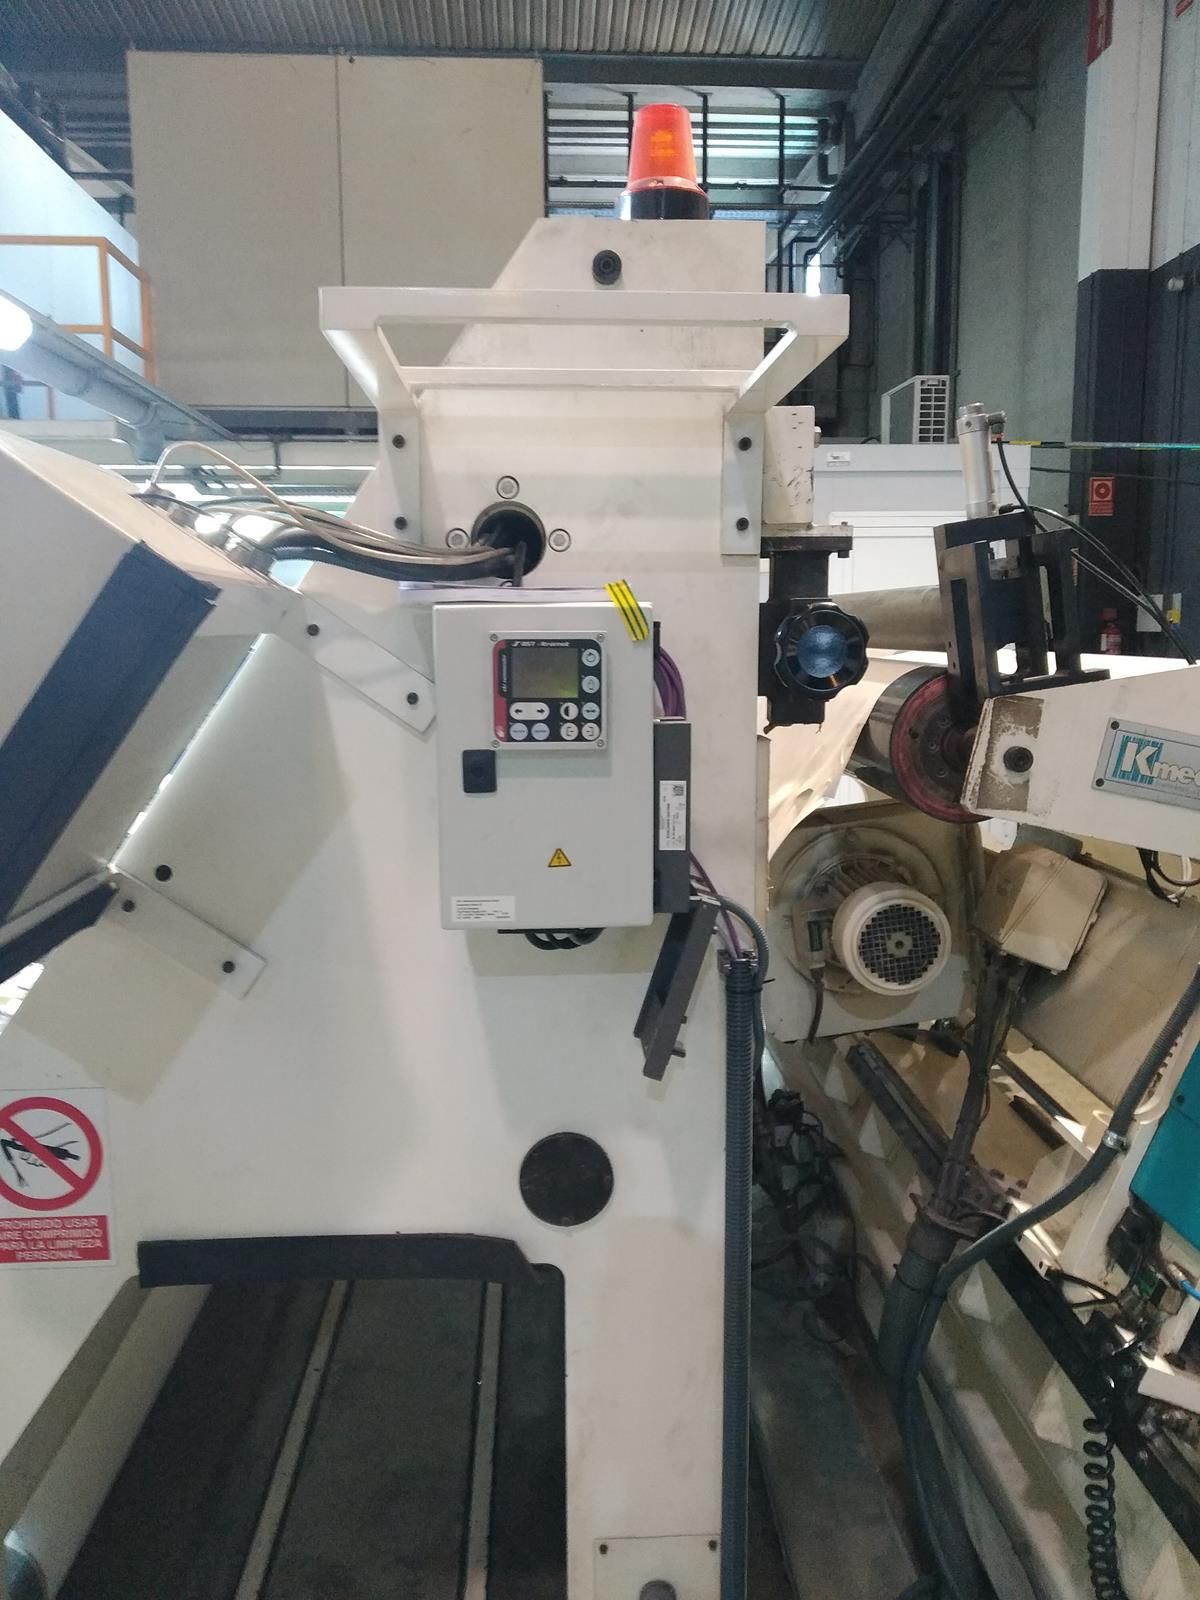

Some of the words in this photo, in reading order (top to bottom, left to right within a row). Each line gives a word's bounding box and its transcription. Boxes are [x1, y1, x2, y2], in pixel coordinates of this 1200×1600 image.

[63, 1217, 98, 1228] USAR
[0, 1230, 21, 1241] IRE
[23, 1228, 103, 1240] COMPRIMIDO
[0, 1240, 27, 1251] ARA
[30, 1240, 46, 1250] LA
[47, 1239, 103, 1250] LIMPIEZA
[15, 1250, 82, 1260] PERSONAL
